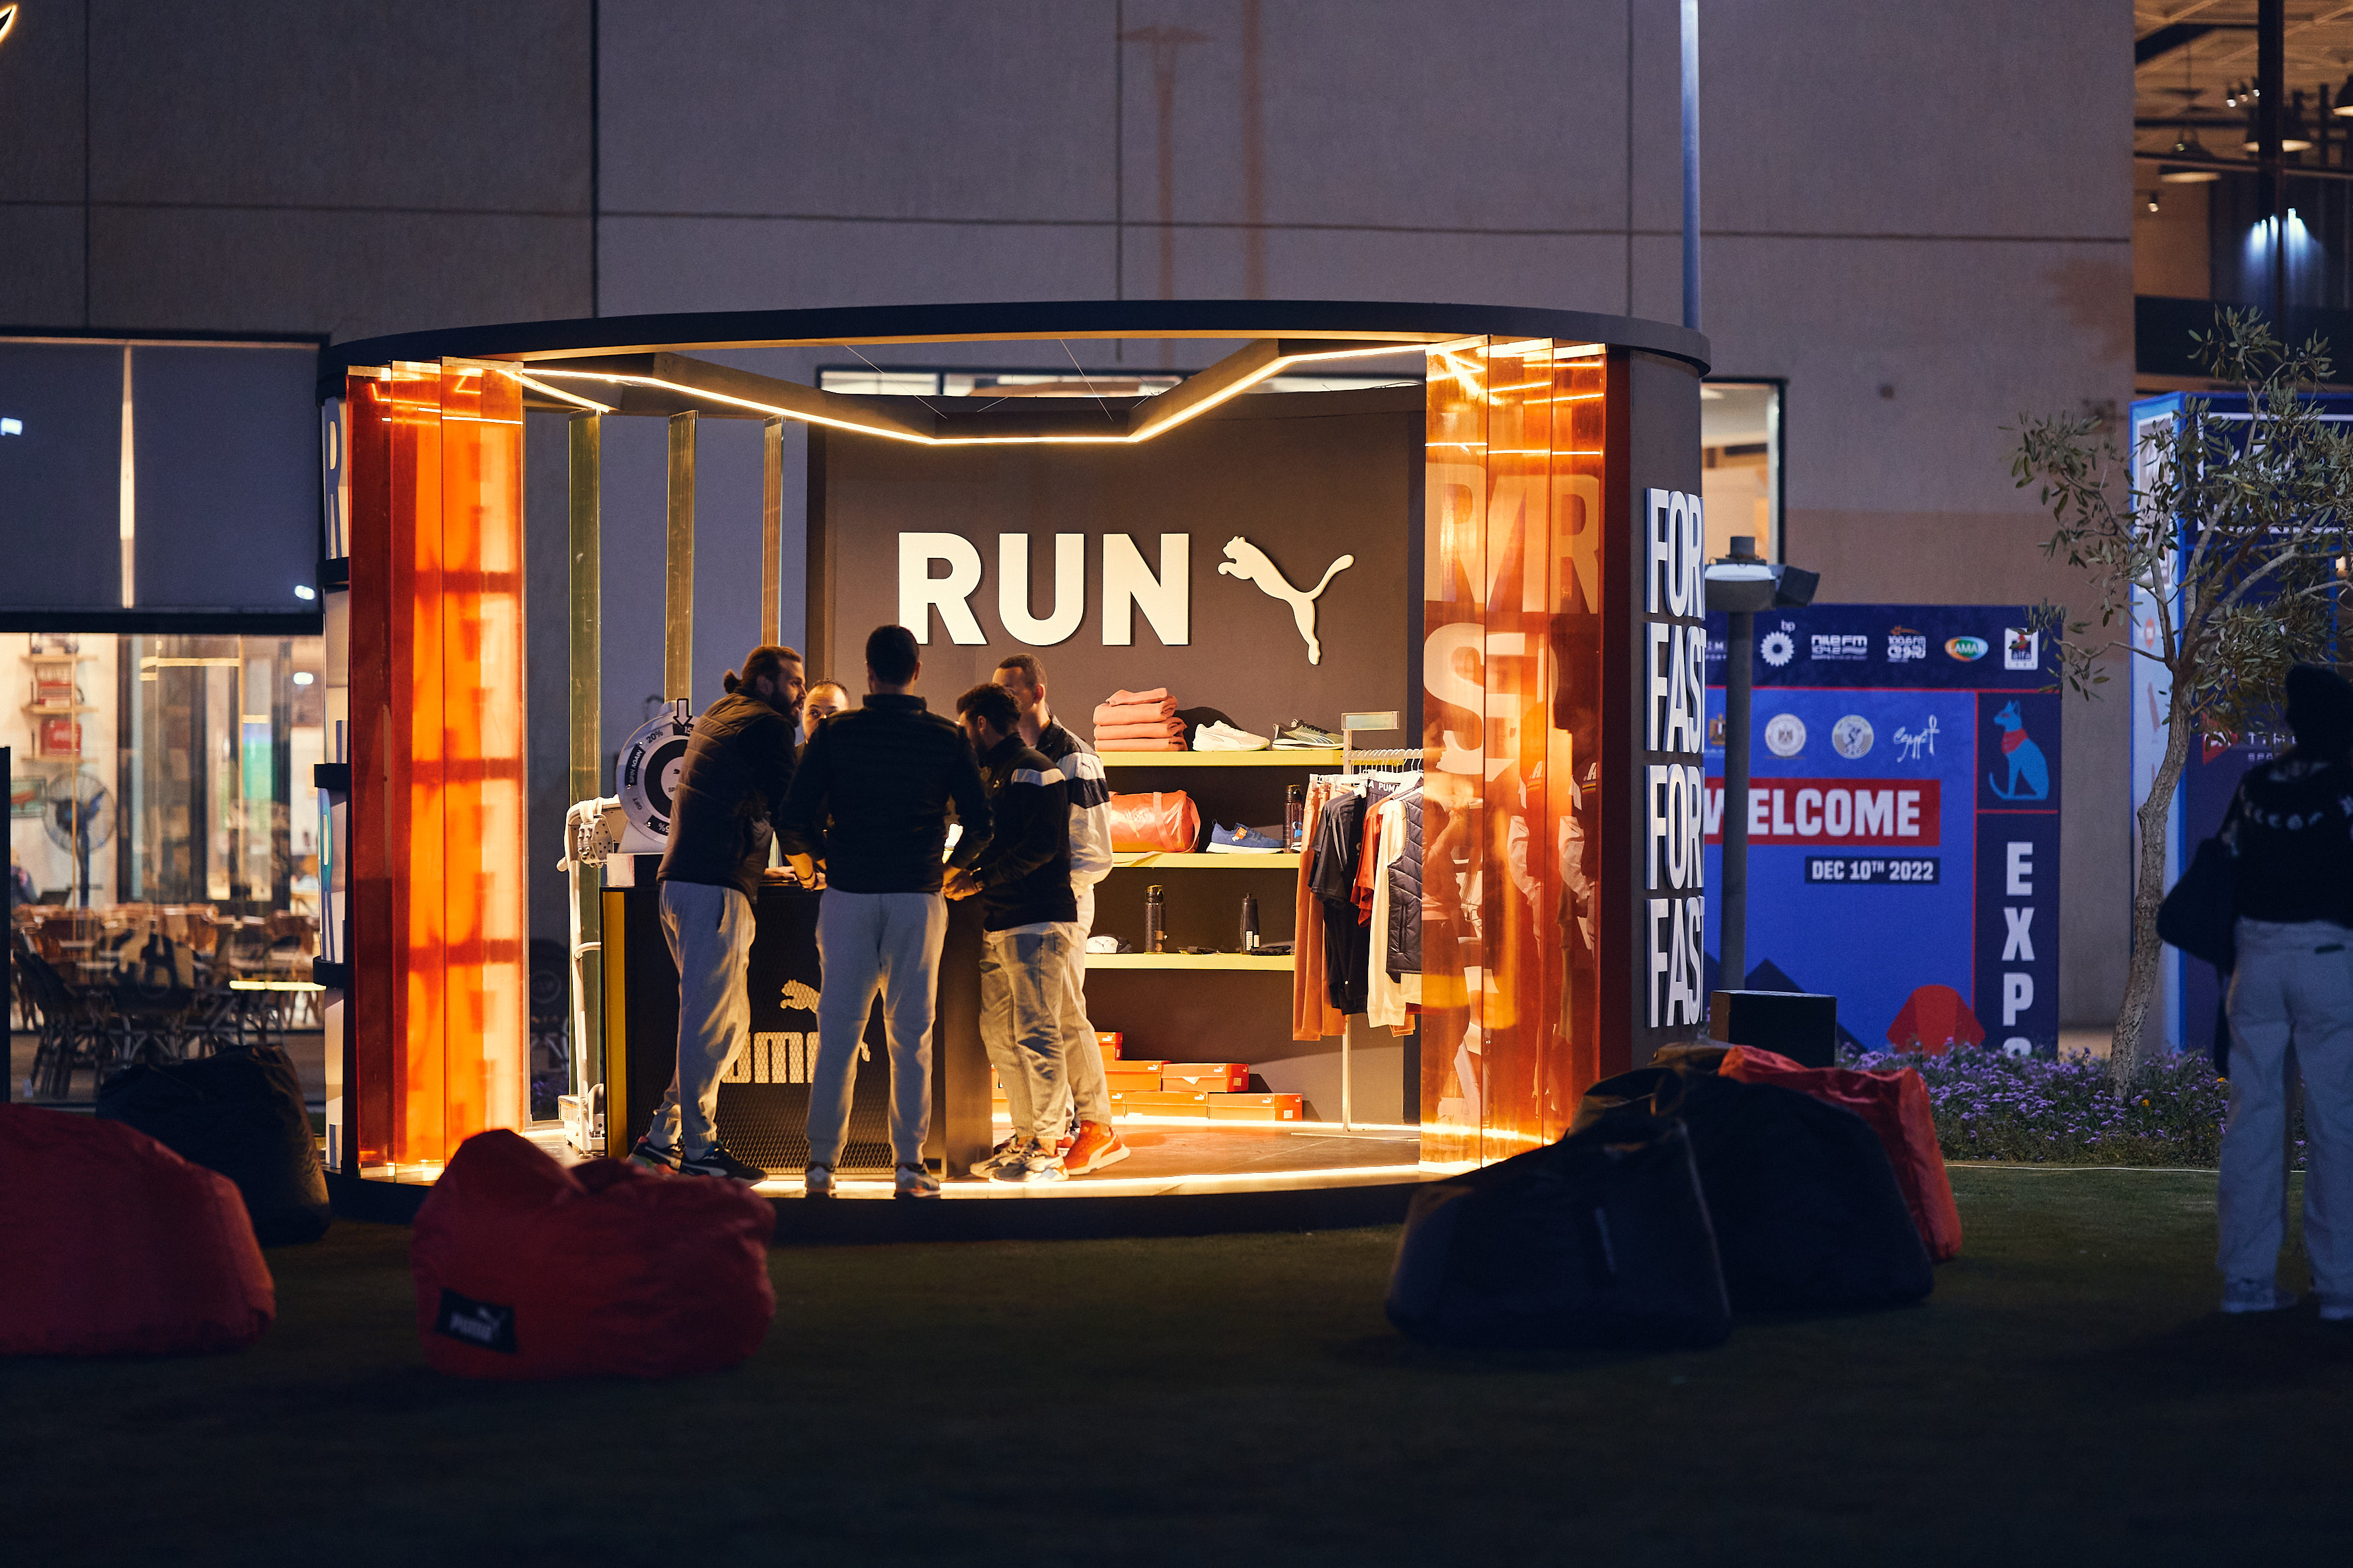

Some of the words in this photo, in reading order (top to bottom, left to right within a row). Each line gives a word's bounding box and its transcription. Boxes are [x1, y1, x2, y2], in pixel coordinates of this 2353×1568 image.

[898, 532, 1189, 646] RUN
[646, 729, 664, 743] 20%
[631, 749, 643, 768] AGAIN
[633, 797, 643, 811] GIFT
[1812, 861, 1844, 880] DEC
[1850, 861, 1885, 880] 10TH
[1890, 861, 1934, 880] 2022
